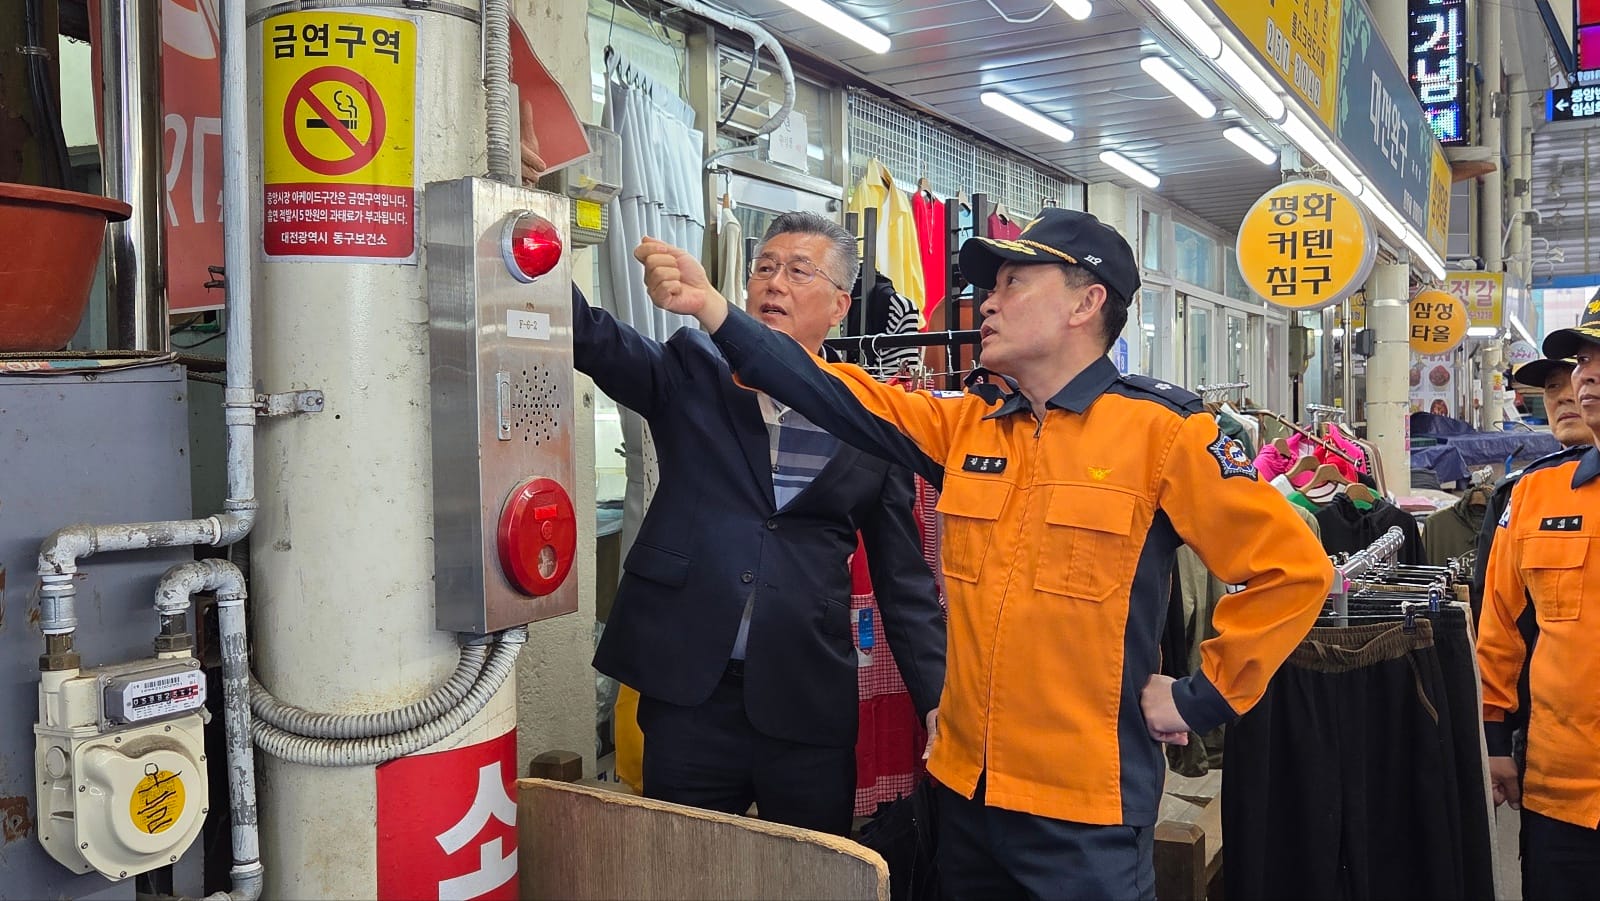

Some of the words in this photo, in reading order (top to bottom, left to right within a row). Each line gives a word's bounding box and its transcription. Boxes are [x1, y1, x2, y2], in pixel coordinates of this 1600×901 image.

[273, 23, 400, 64] 금연구역
[1369, 69, 1409, 178] 대전완구
[266, 192, 291, 205] 중앙시장
[292, 191, 347, 205] 아케이드구간은
[348, 192, 408, 207] 금연구역입니다.
[1268, 192, 1337, 226] 평화
[330, 210, 363, 223] 과태료가
[365, 210, 408, 225] 부과됩니다.
[281, 231, 328, 244] 대전광역시
[332, 232, 388, 246] 동구보건소
[1267, 228, 1333, 260] 커텐
[1266, 265, 1332, 296] 침구
[1413, 302, 1453, 320] 삼성
[1411, 324, 1451, 343] 타올
[435, 760, 518, 901] 소
